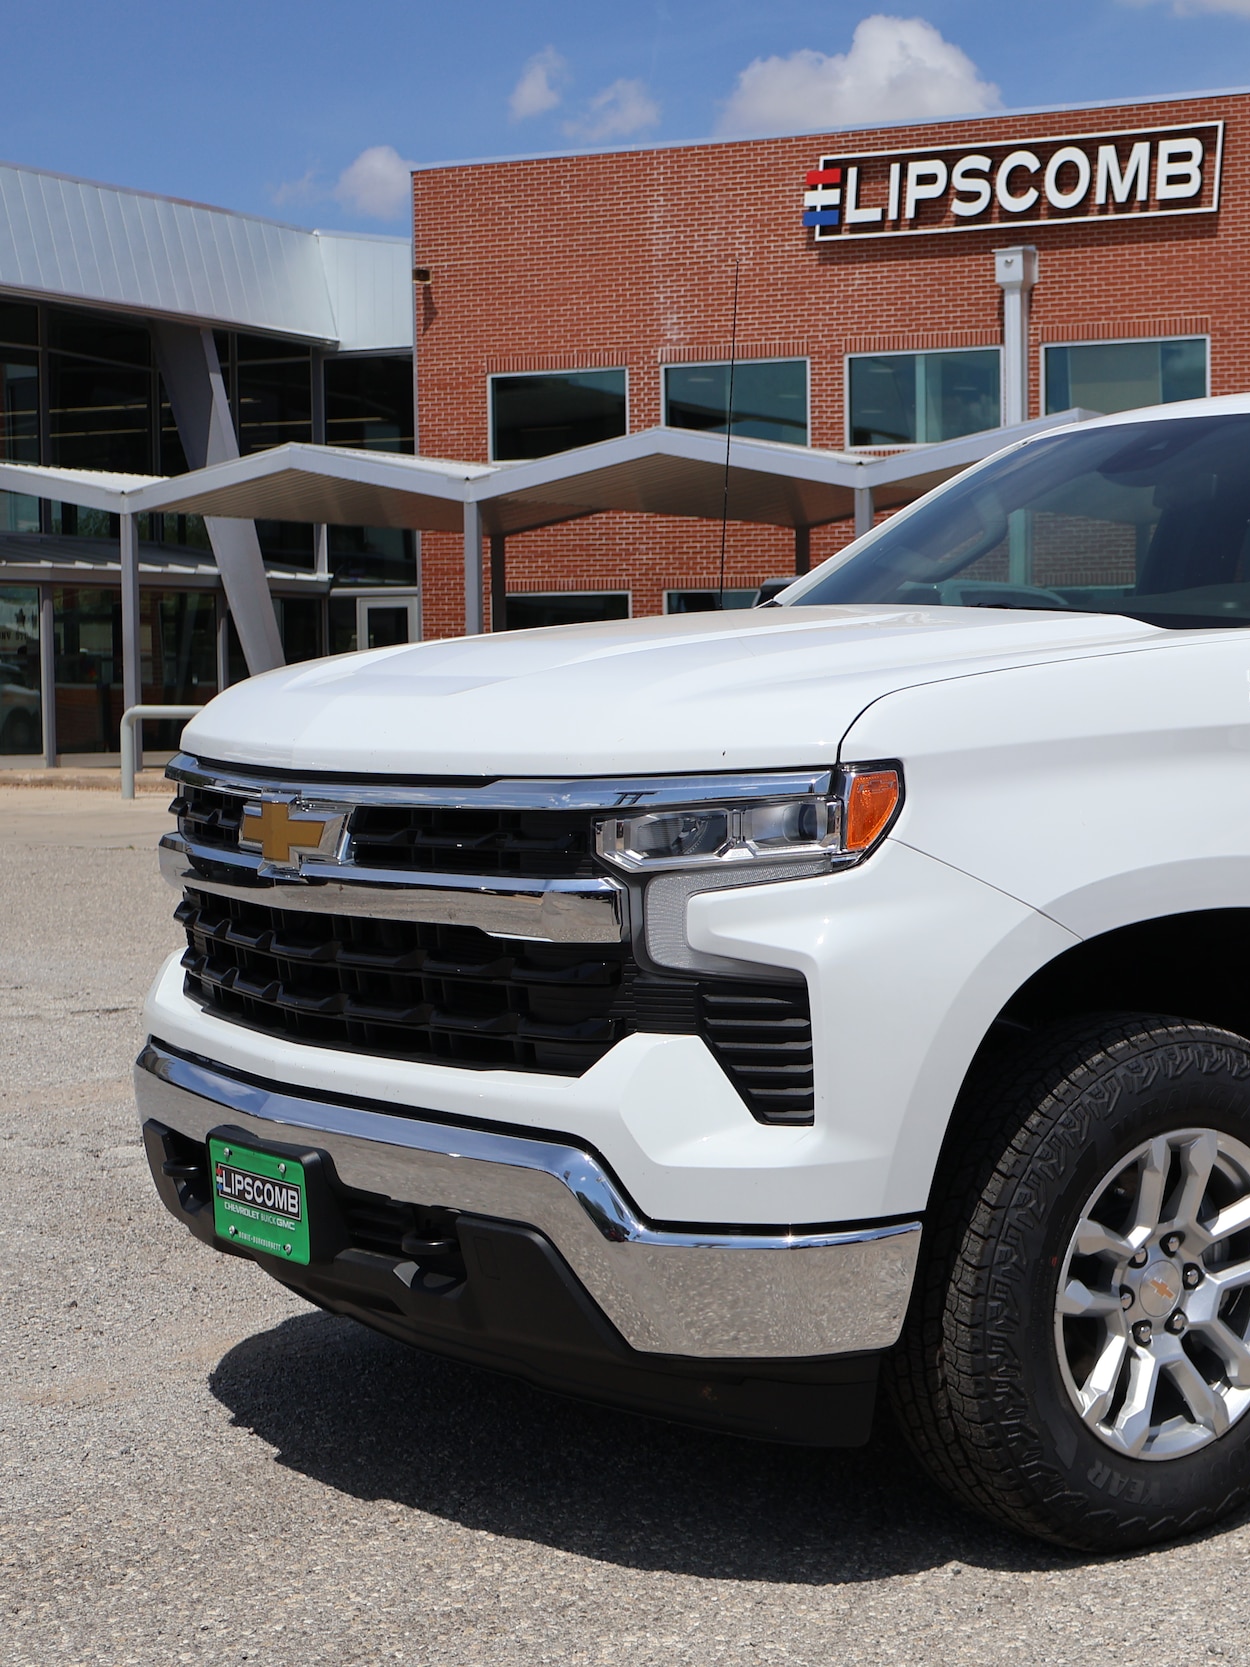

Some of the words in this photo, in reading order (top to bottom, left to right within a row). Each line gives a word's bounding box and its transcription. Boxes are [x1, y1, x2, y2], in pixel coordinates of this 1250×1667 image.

[845, 137, 1203, 225] LIPSCOMB
[222, 1169, 299, 1214] LIPSCOMB
[224, 1201, 260, 1220] CHEVROLET
[276, 1218, 296, 1231] GMC
